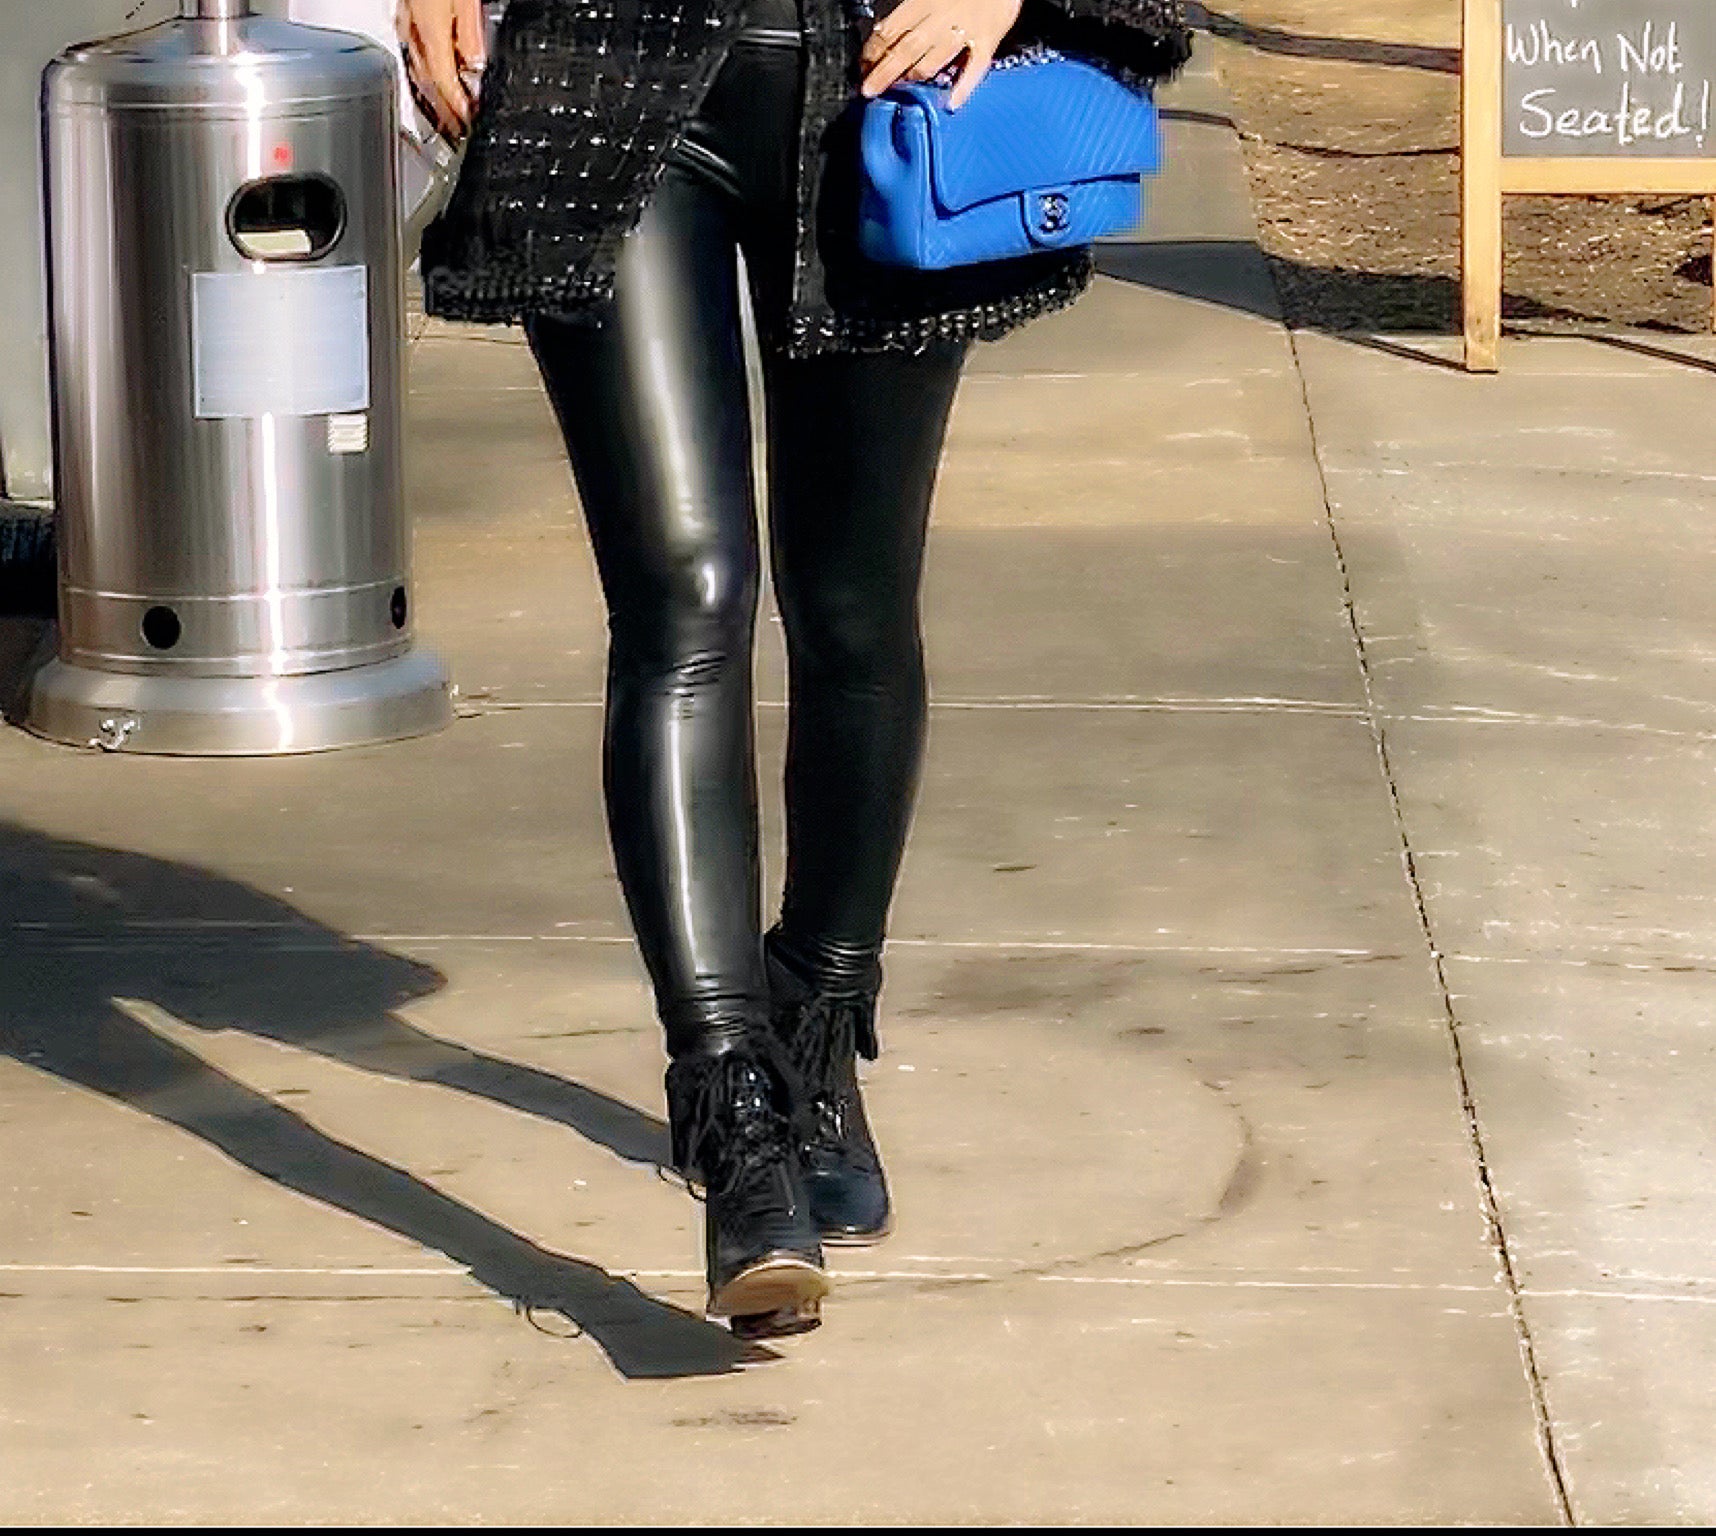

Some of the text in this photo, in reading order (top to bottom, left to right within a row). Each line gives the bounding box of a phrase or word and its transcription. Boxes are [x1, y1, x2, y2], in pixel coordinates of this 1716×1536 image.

[1507, 19, 1684, 74] When Not
[1519, 79, 1709, 148] Seated!
